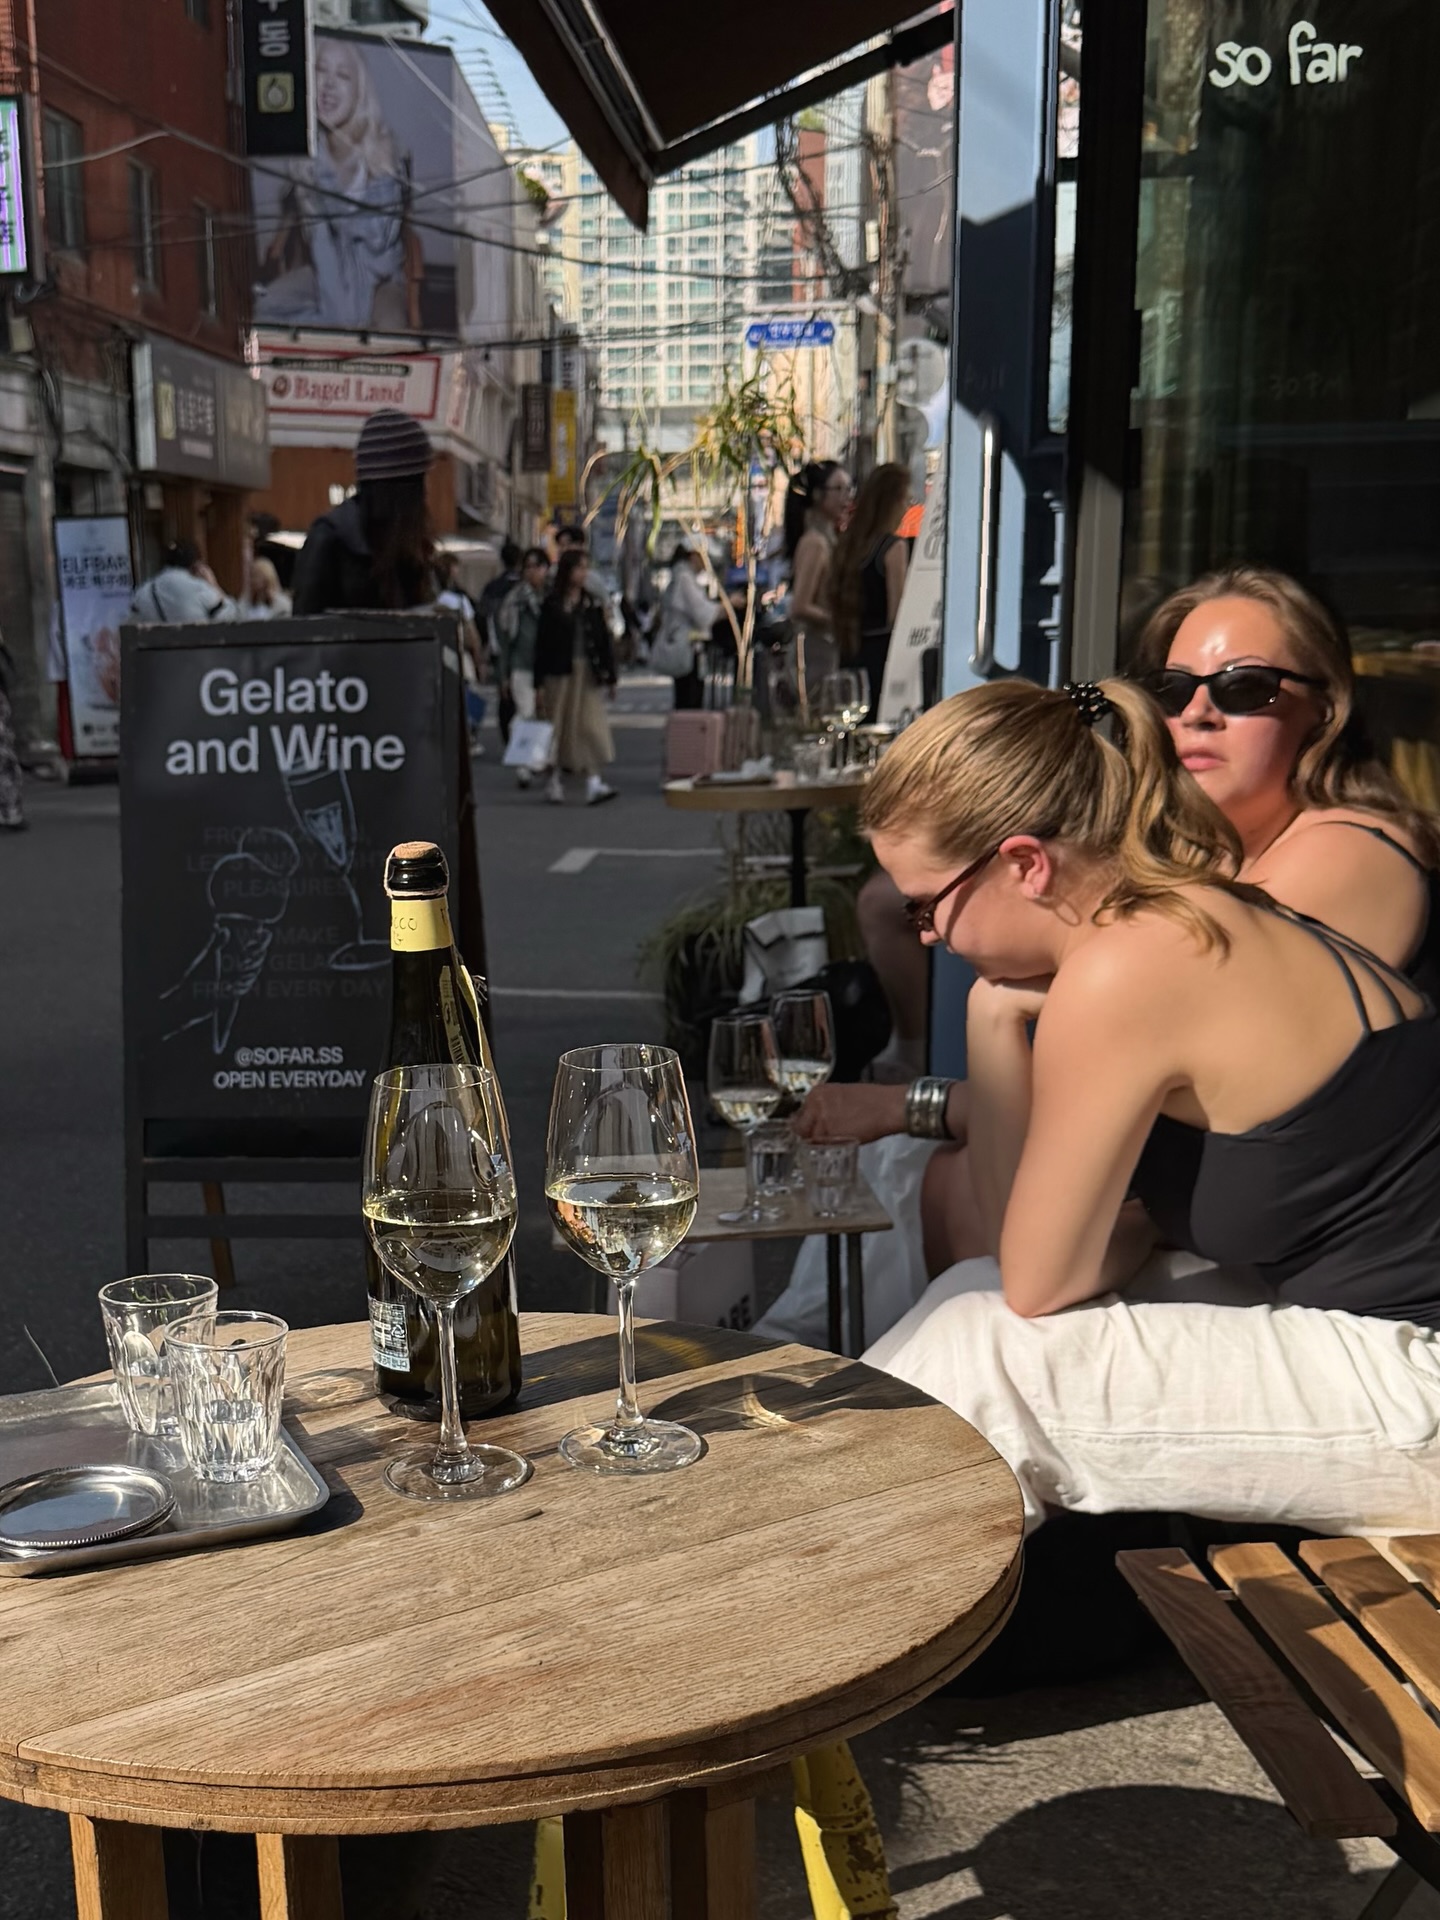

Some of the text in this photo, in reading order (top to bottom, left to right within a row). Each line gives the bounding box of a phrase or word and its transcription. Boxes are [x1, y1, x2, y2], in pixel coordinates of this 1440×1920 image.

[1208, 20, 1364, 88] so far
[294, 375, 406, 407] Bagel Land
[200, 666, 368, 716] Gelato
[166, 724, 406, 775] and Wine
[266, 981, 336, 997] EVERY
[341, 980, 387, 998] DAY
[234, 1047, 344, 1067] @SOFAR.SS
[213, 1069, 366, 1089] OPEN EVERYDAY
